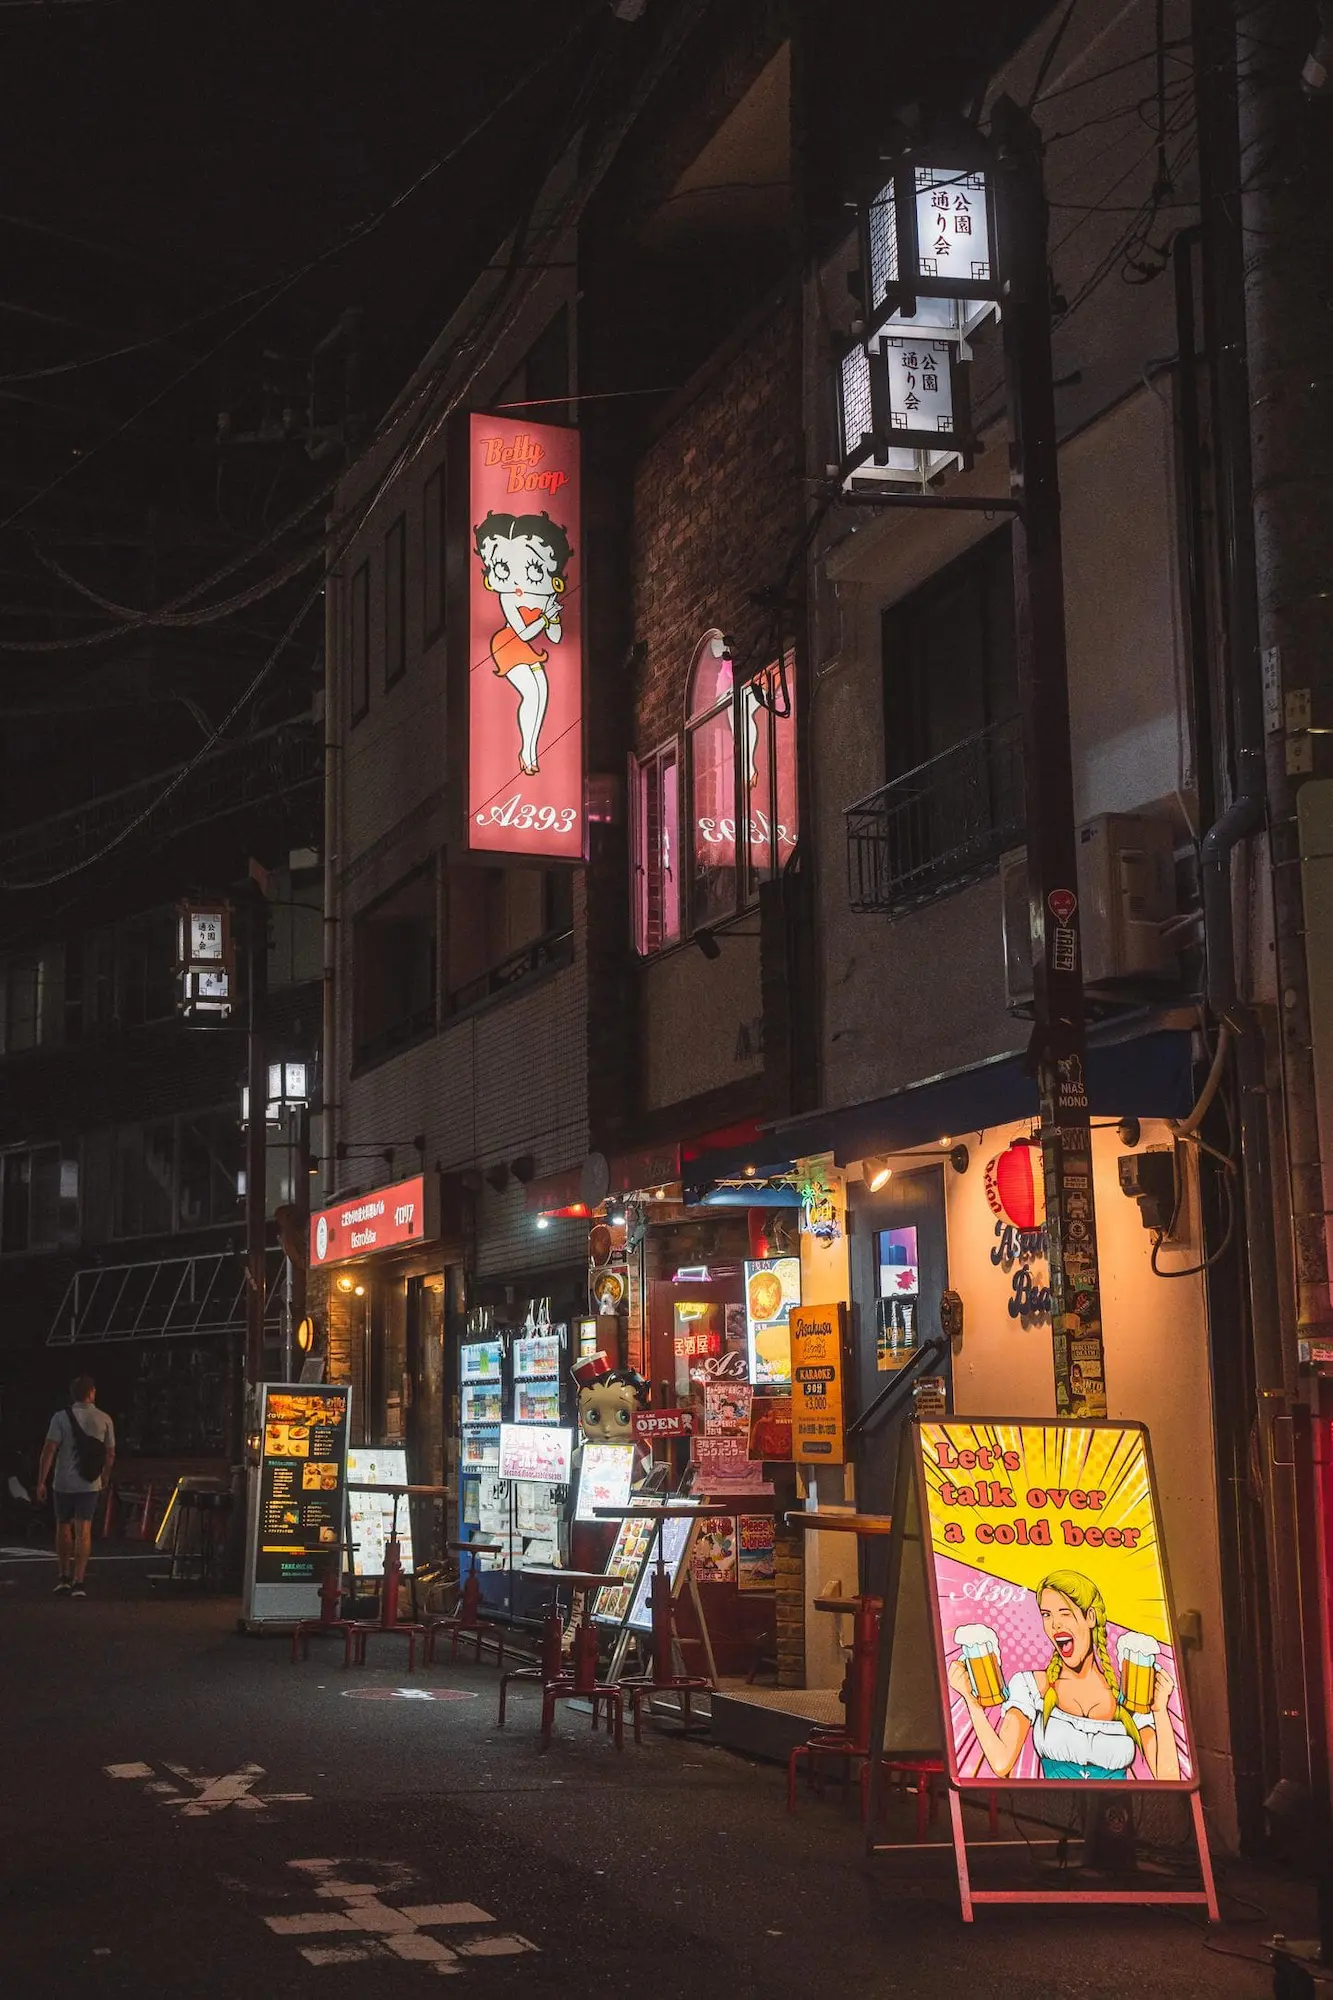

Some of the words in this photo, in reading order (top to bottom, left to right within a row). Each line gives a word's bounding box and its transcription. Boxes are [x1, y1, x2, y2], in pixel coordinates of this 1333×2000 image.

[931, 191, 952, 256] 通り会
[951, 191, 973, 236] 公園
[901, 352, 921, 411] 通り会
[920, 352, 939, 393] 公園
[480, 434, 546, 466] Betty
[503, 463, 570, 496] Boop
[475, 794, 577, 833] A393
[1059, 1095, 1088, 1107] MONO
[795, 1318, 832, 1340] Asakusa
[799, 1369, 831, 1380] KARAOKE
[636, 1416, 679, 1431] OPEN
[935, 1442, 1021, 1473] Let's
[939, 1480, 1017, 1508] talk
[1027, 1486, 1107, 1512] over
[944, 1521, 965, 1544] a
[974, 1518, 1052, 1547] cold
[1061, 1521, 1141, 1550] beer
[949, 1575, 1029, 1609] A393
